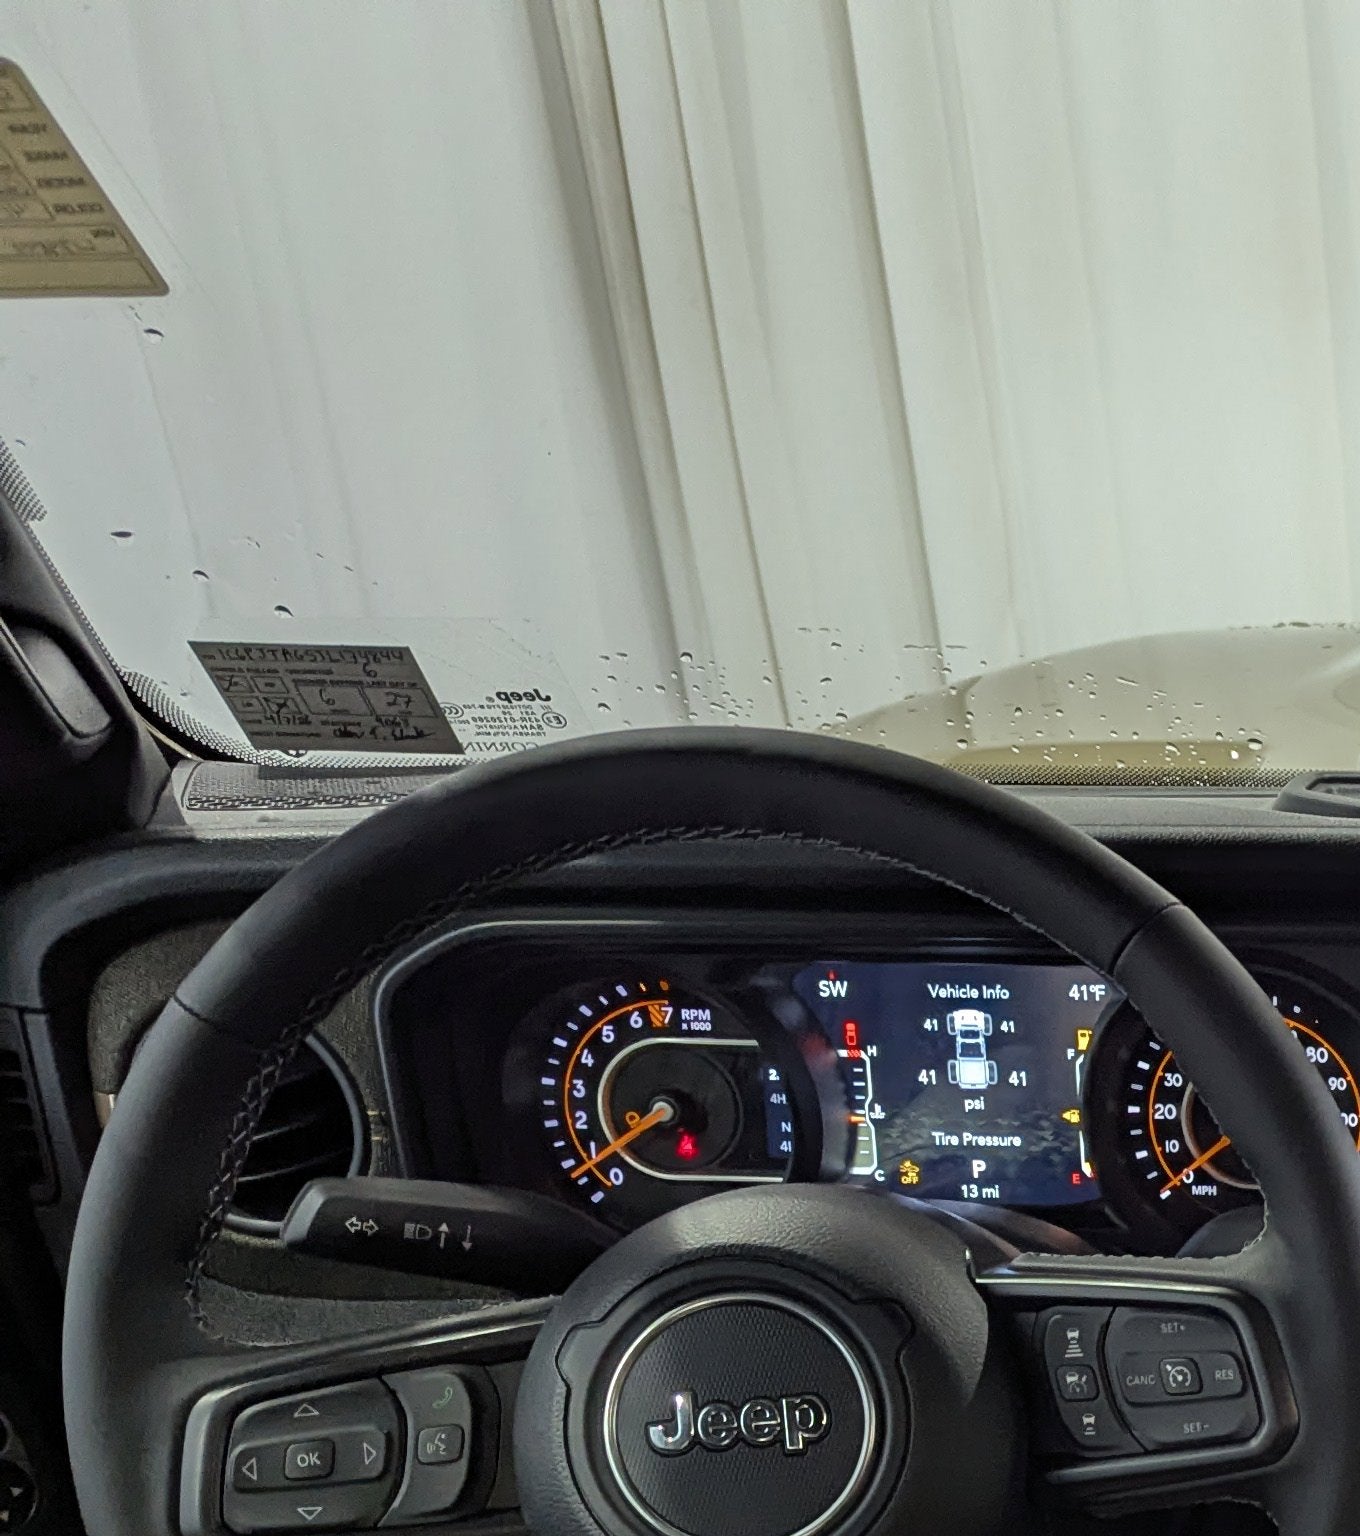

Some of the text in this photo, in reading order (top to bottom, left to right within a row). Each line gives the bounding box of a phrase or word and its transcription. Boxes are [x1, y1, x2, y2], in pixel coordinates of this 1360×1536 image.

[819, 981, 848, 998] SW
[927, 983, 1010, 1000] Vehicle Info
[1068, 985, 1106, 1001] 41°F
[629, 1011, 643, 1028] 6
[661, 1007, 673, 1024] 7
[681, 1009, 711, 1021] RPM
[690, 1022, 712, 1031] 1000
[923, 1019, 938, 1032] 41
[1000, 1020, 1015, 1033] 41
[601, 1025, 615, 1043] 5
[580, 1049, 594, 1067] 4
[867, 1046, 877, 1057] H
[1067, 1049, 1075, 1060] F
[918, 1069, 937, 1085] 41
[1008, 1071, 1027, 1087] 41
[1164, 1073, 1183, 1087] 30
[1327, 1077, 1347, 1092] 90
[572, 1079, 586, 1098] 3
[769, 1093, 787, 1105] 4H
[964, 1097, 985, 1113] psi
[1154, 1104, 1177, 1120] 20
[575, 1111, 588, 1129] 2
[781, 1122, 792, 1132] N
[932, 1131, 1022, 1148] Tire Pressure
[1165, 1140, 1179, 1153] 10
[609, 1167, 623, 1185] 0
[874, 1170, 885, 1182] C
[972, 1160, 987, 1178] P
[1182, 1169, 1194, 1184] 0
[901, 1175, 919, 1185] OFF
[1072, 1173, 1080, 1184] E
[961, 1185, 1000, 1199] 13 mi
[1192, 1185, 1217, 1197] MPH
[1126, 1373, 1156, 1387] CANC
[1214, 1369, 1234, 1382] RES
[648, 1391, 828, 1451] Jeep
[297, 1452, 321, 1467] OK
